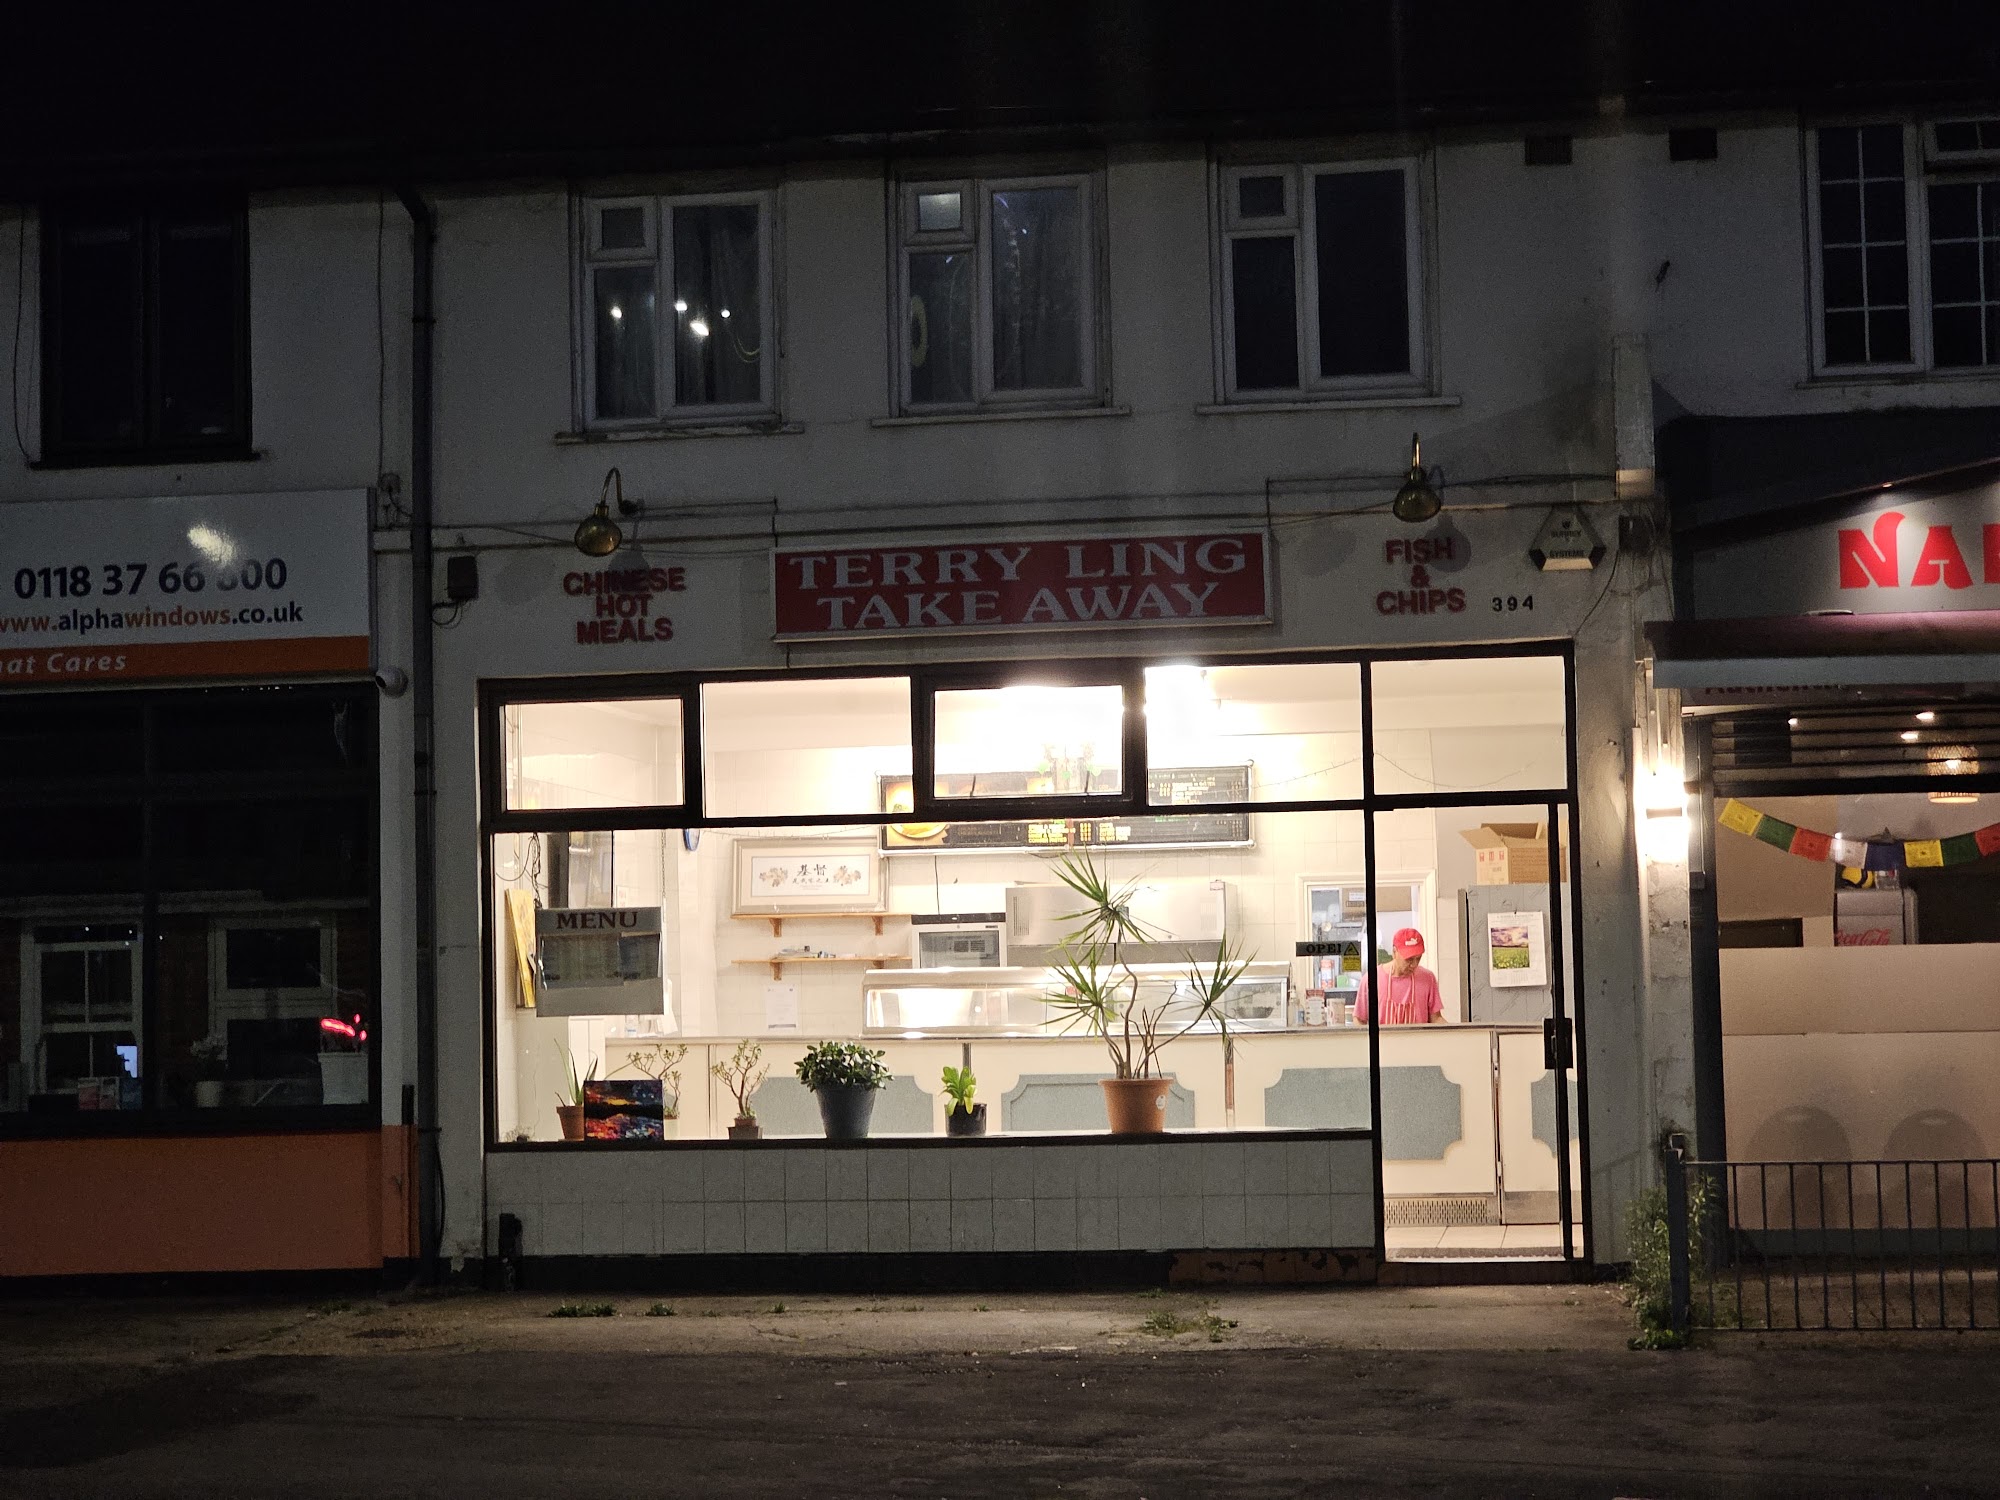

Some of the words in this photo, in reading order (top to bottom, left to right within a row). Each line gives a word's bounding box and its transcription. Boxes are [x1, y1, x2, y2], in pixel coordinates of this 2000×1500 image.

[789, 547, 1032, 590] TERRY
[1064, 538, 1246, 579] LING
[1384, 537, 1457, 565] FISH
[1838, 511, 2000, 590] NA
[14, 565, 92, 600] 0118
[102, 563, 148, 596] 37
[158, 561, 206, 594] 66
[562, 566, 687, 597] CHINESE
[1410, 564, 1431, 588] &
[595, 593, 653, 619] HOT
[816, 590, 1002, 631] TAKE
[1021, 582, 1219, 622] AWAY
[1376, 587, 1467, 616] CHIPS
[1491, 594, 1534, 612] 394
[576, 616, 674, 645] MEALS
[0, 654, 38, 675] at
[46, 651, 127, 673] Cares
[556, 911, 638, 930] MENU
